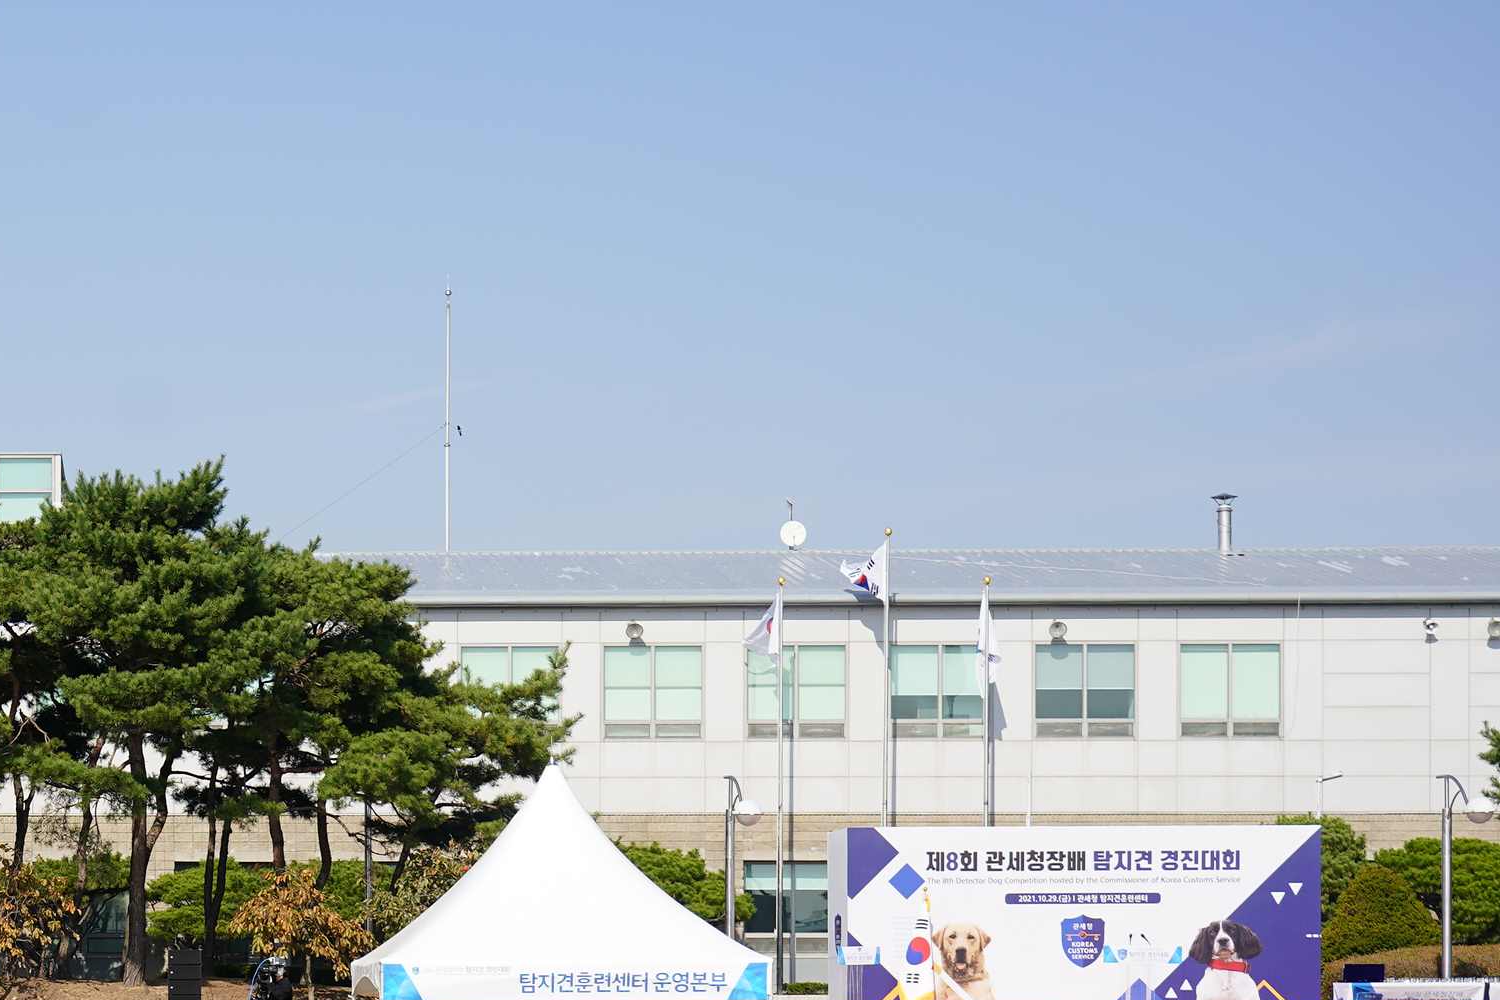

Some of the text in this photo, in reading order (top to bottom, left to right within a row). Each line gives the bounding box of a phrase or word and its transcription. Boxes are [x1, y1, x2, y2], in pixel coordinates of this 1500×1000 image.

[926, 849, 1241, 872] 제8회 관세청장배 탐지견 경진대회
[518, 971, 729, 994] 탐지견훈련센터 운영본부
